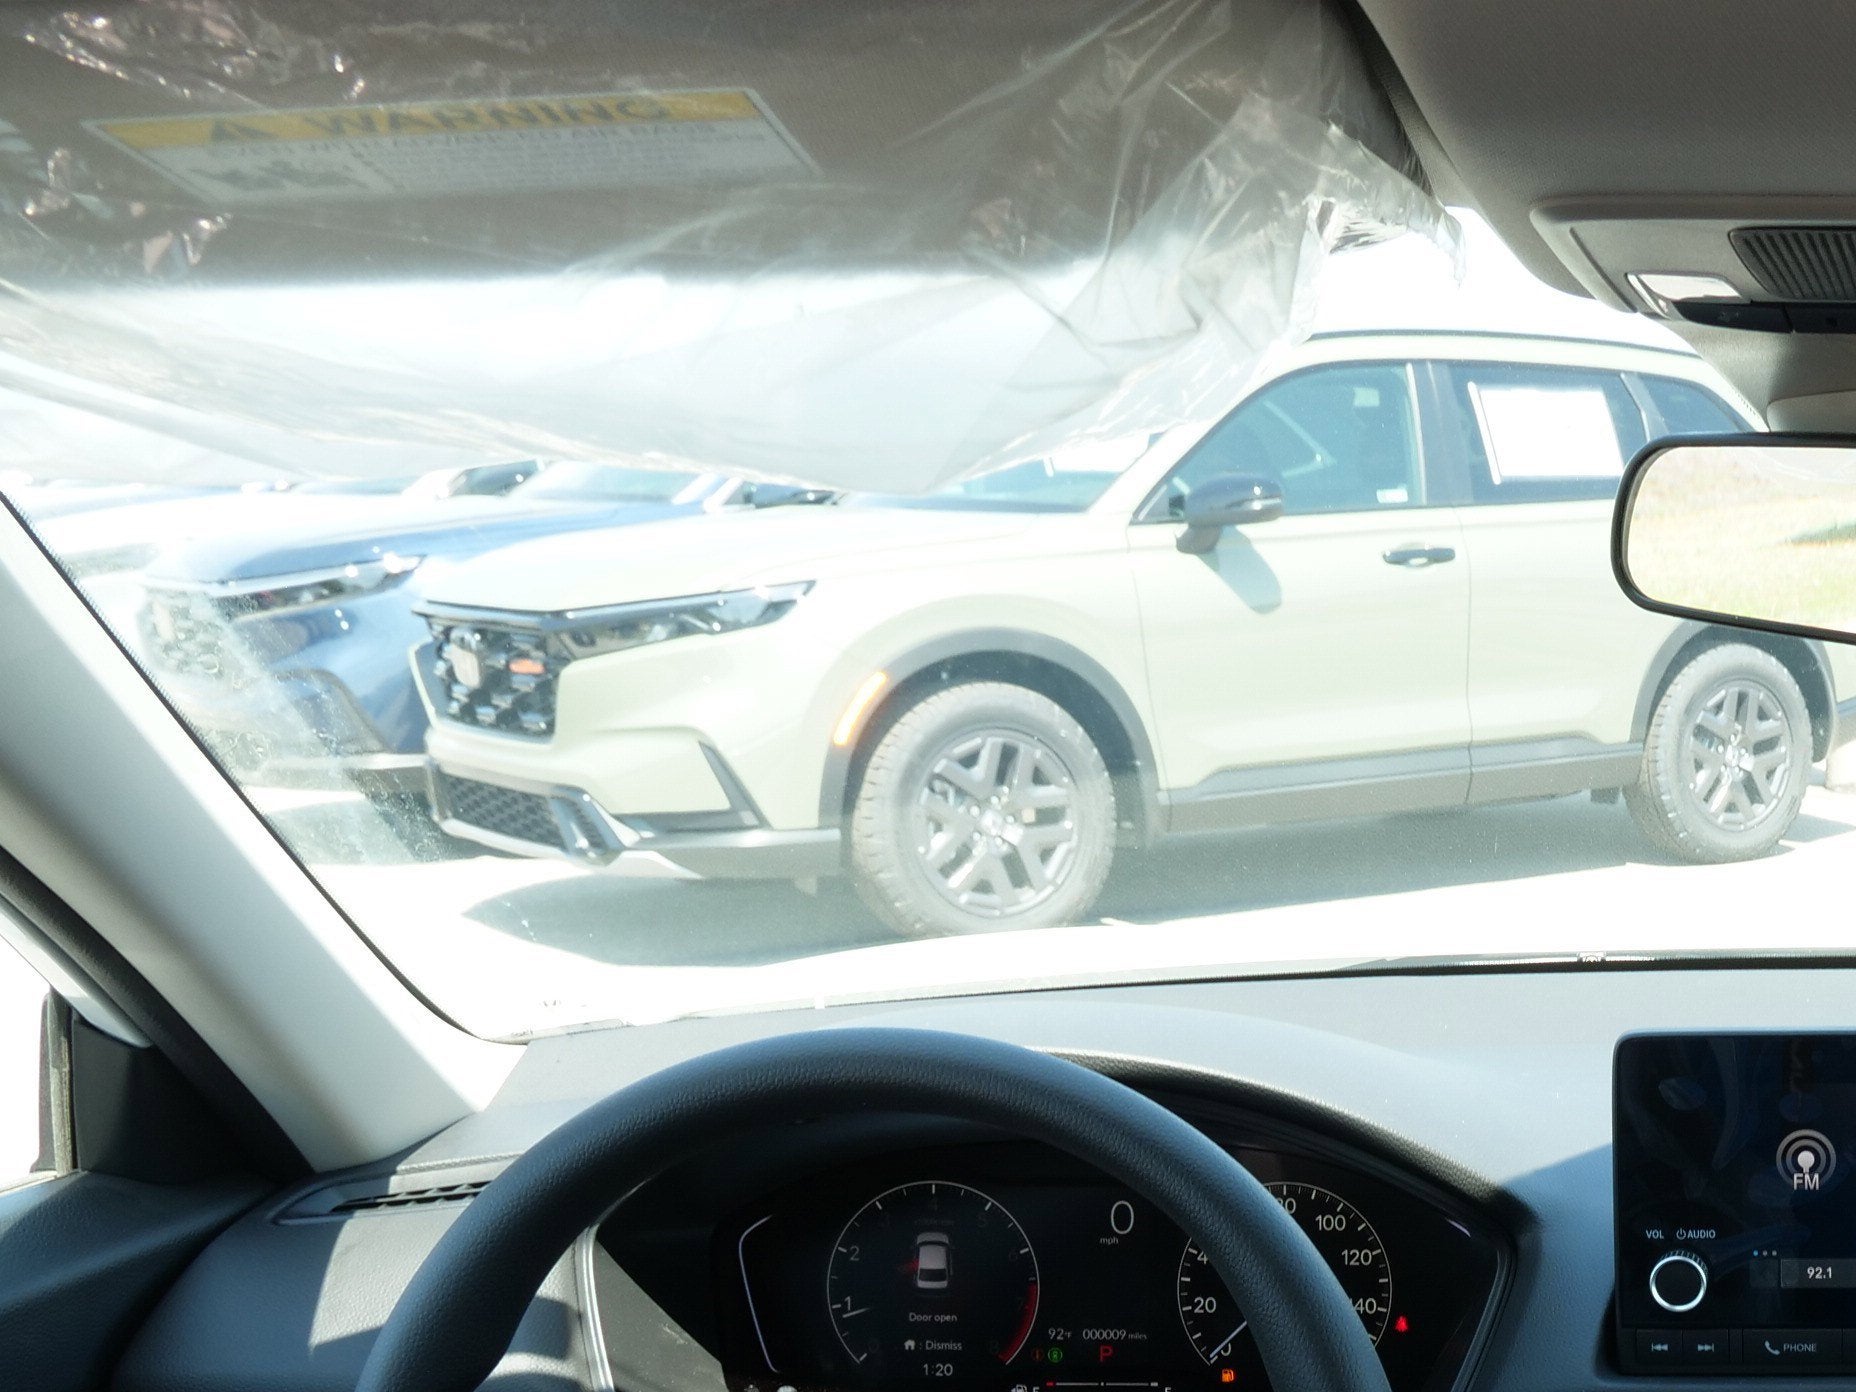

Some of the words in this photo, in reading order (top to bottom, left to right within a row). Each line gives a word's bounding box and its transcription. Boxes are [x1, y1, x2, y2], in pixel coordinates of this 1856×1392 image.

[304, 95, 668, 140] WARNING
[1793, 1173, 1820, 1191] FM
[1110, 1200, 1135, 1235] 0
[1315, 1213, 1346, 1231] 100
[1100, 1236, 1119, 1246] mph
[1645, 1229, 1664, 1239] VOL
[1687, 1229, 1716, 1240] AUDIO
[849, 1245, 860, 1261] 2
[1341, 1248, 1373, 1266] 120
[1807, 1266, 1833, 1279] 92.1
[844, 1296, 852, 1311] 1
[1194, 1296, 1217, 1314] 20
[1350, 1297, 1377, 1315] 40
[909, 1312, 932, 1322] Door
[933, 1313, 959, 1324] open
[1082, 1328, 1127, 1340] 000009
[925, 1340, 963, 1351] Dismiss
[1782, 1342, 1817, 1353] PHONE
[1099, 1344, 1115, 1363] P
[923, 1363, 954, 1377] 1:20
